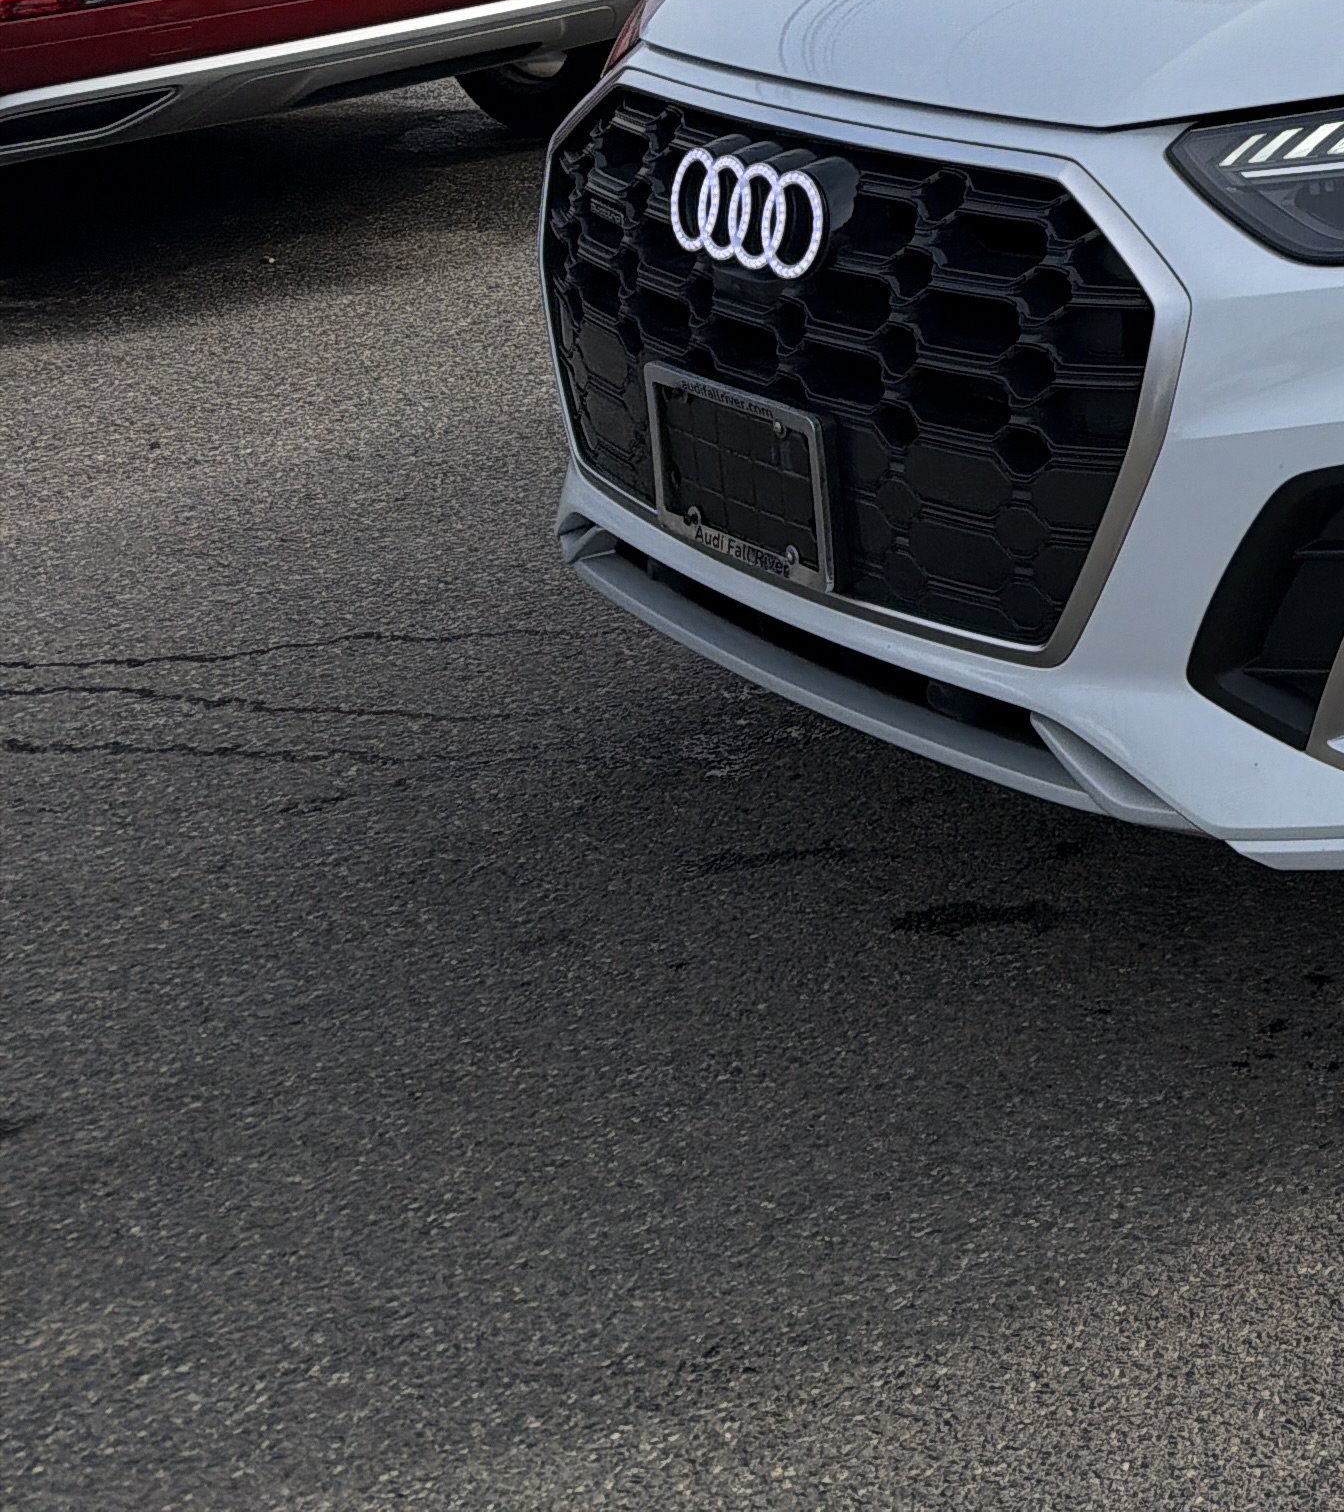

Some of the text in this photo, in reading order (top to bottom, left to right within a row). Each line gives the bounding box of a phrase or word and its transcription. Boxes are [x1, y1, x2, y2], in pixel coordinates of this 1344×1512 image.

[694, 528, 791, 578] Audi Fall River
